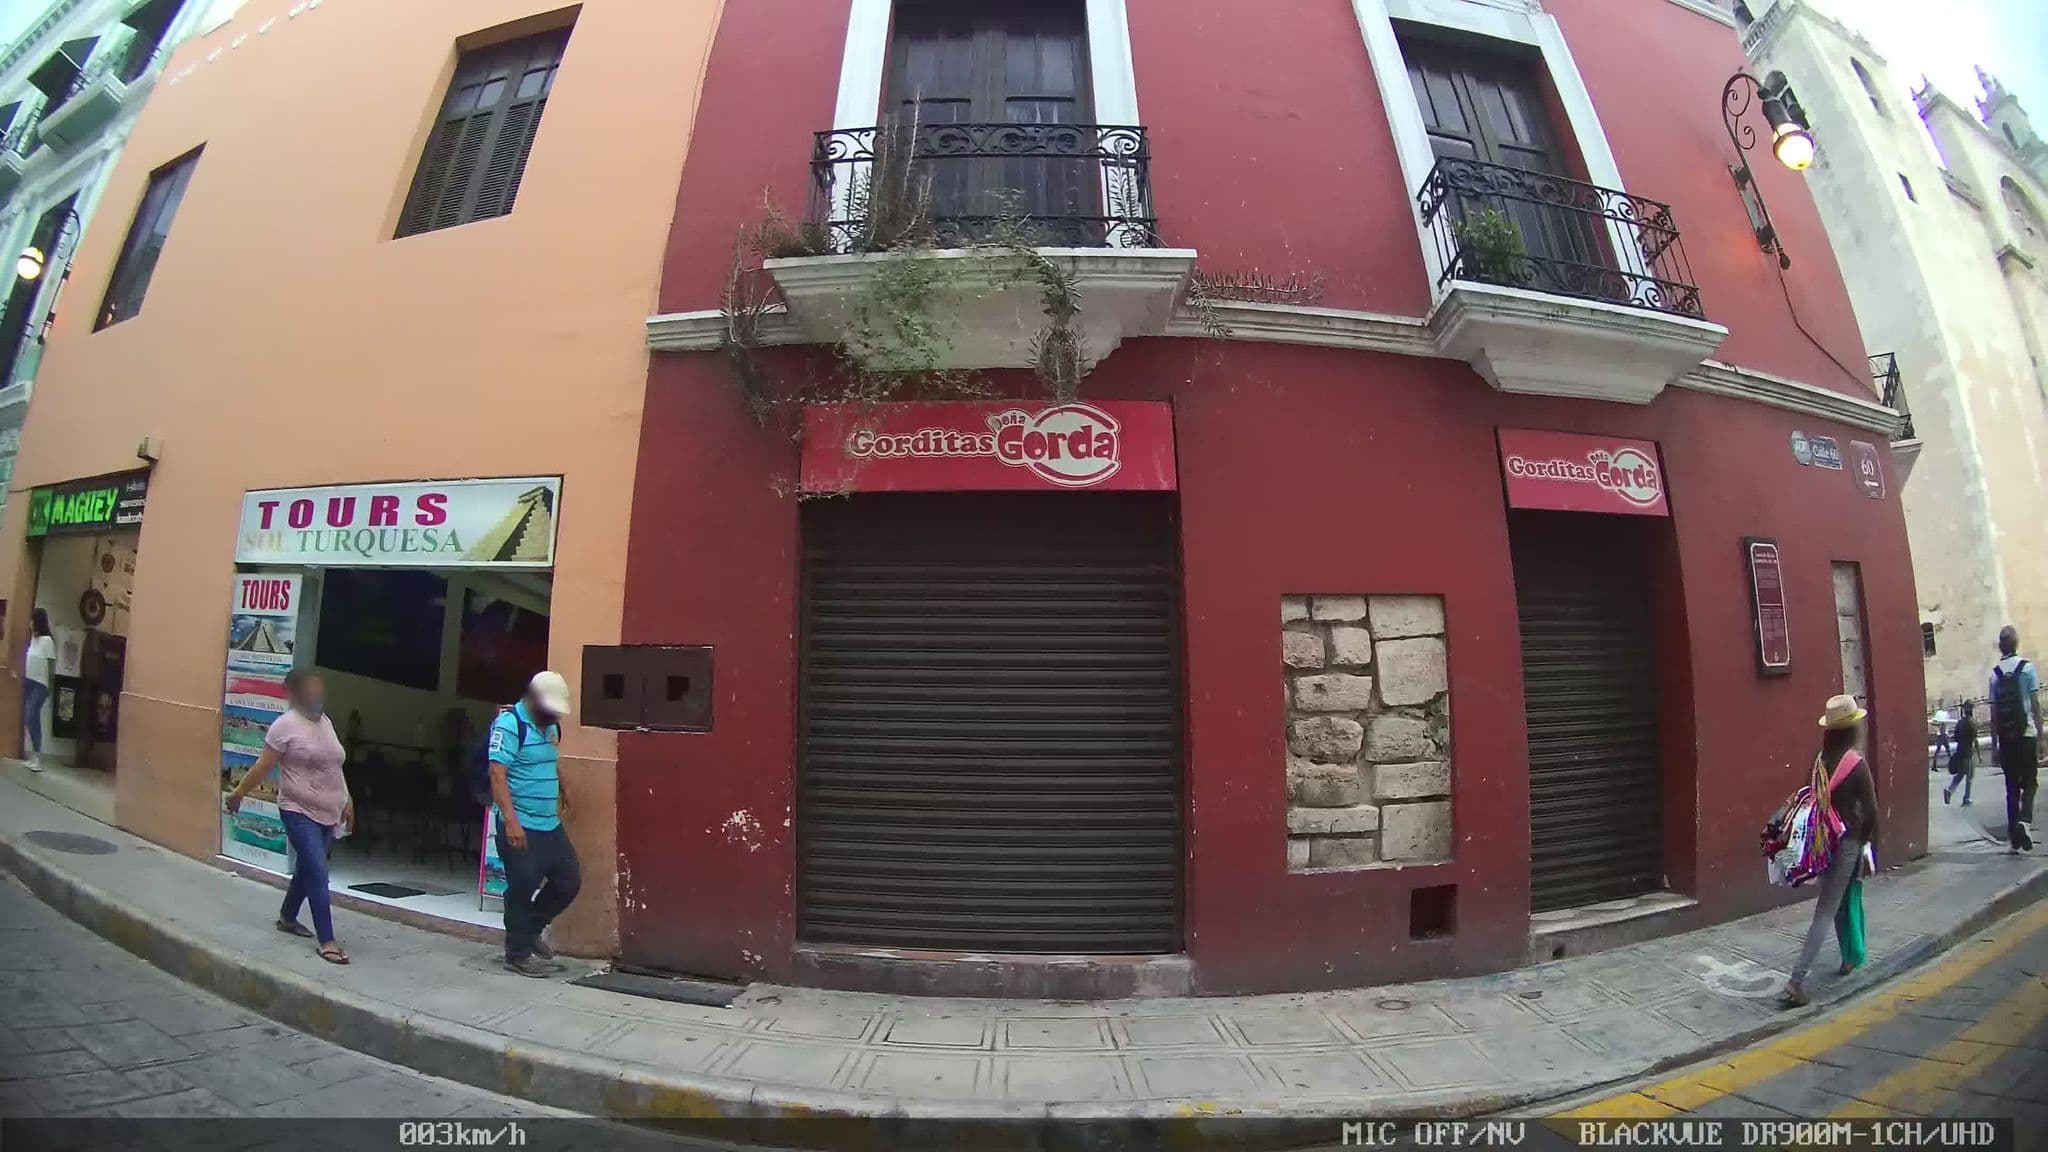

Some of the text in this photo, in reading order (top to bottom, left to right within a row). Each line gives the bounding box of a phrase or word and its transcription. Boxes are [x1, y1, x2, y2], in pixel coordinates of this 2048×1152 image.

[852, 424, 1115, 462] Gorditas Gorda
[1508, 457, 1658, 489] Gorditas Gorda
[50, 487, 118, 525] MAGUEY
[258, 493, 449, 530] TOURS
[297, 527, 464, 557] TURQUESA
[241, 579, 291, 611] TOURS
